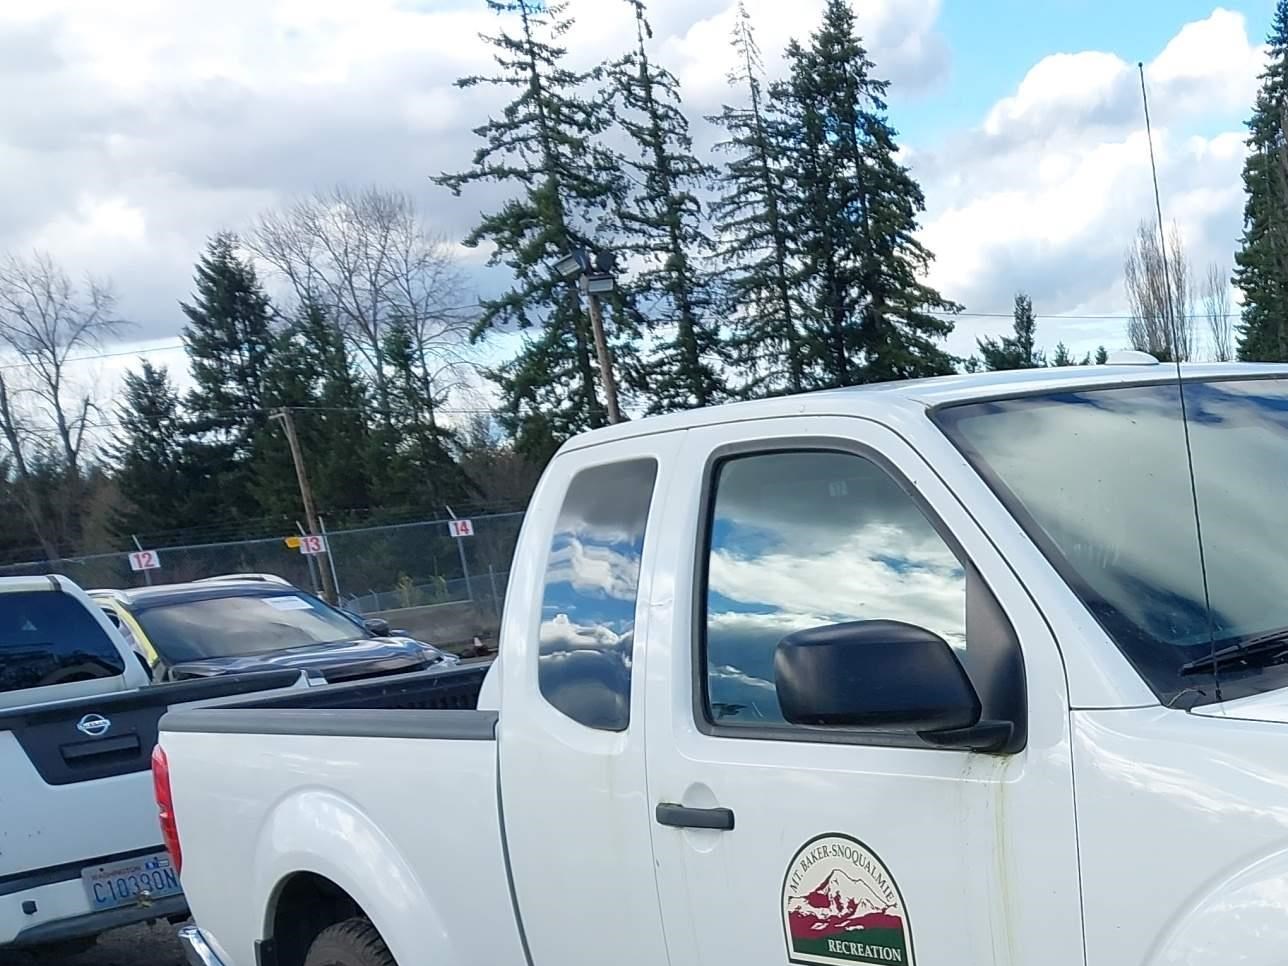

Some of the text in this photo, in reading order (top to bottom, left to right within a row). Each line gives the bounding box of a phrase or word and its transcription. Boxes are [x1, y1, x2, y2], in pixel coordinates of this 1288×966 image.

[453, 520, 470, 536] 14
[303, 536, 321, 552] 13
[133, 551, 155, 569] 12
[789, 843, 895, 902] MT. BAKER-SNOQUALMIE
[828, 939, 902, 962] RECREATION
